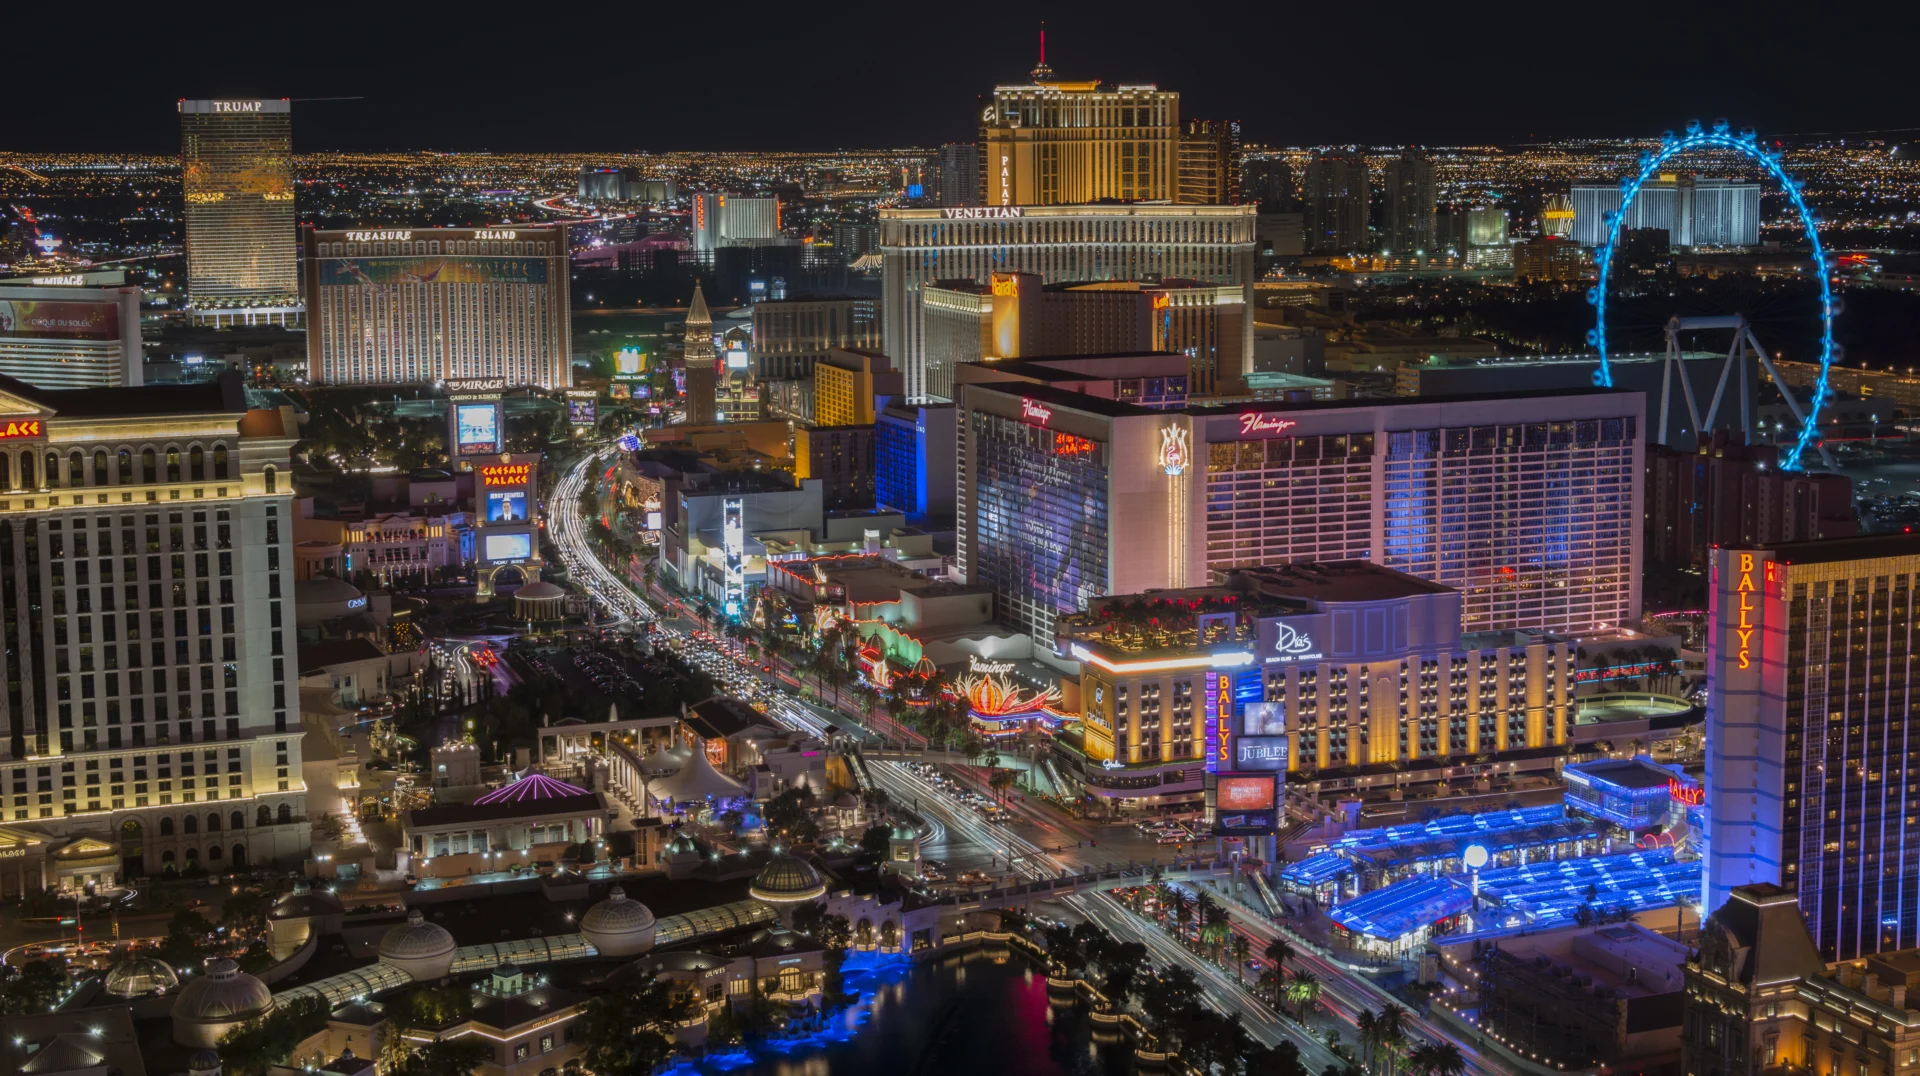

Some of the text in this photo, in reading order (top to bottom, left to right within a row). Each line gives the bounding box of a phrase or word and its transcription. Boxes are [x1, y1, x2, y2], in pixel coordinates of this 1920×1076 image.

[213, 102, 262, 112] TRUMP
[945, 207, 1021, 218] VENETIAN
[346, 230, 516, 241] TREASURE ISLAND
[43, 275, 83, 286] MIRAGE
[31, 319, 56, 328] CIRQUE
[69, 320, 93, 328] SOLEIL
[457, 380, 504, 391] MIRAGE
[1023, 398, 1051, 425] Flamingo
[1240, 413, 1296, 434] Flamingo
[482, 465, 530, 476] CAESARS
[485, 475, 528, 486] PALACE
[1736, 553, 1756, 670] BALLYS
[969, 654, 1016, 680] Flamingo
[1217, 675, 1231, 762] BALLYS
[1237, 746, 1288, 762] JUBILEE
[705, 966, 726, 979] OLIVES
